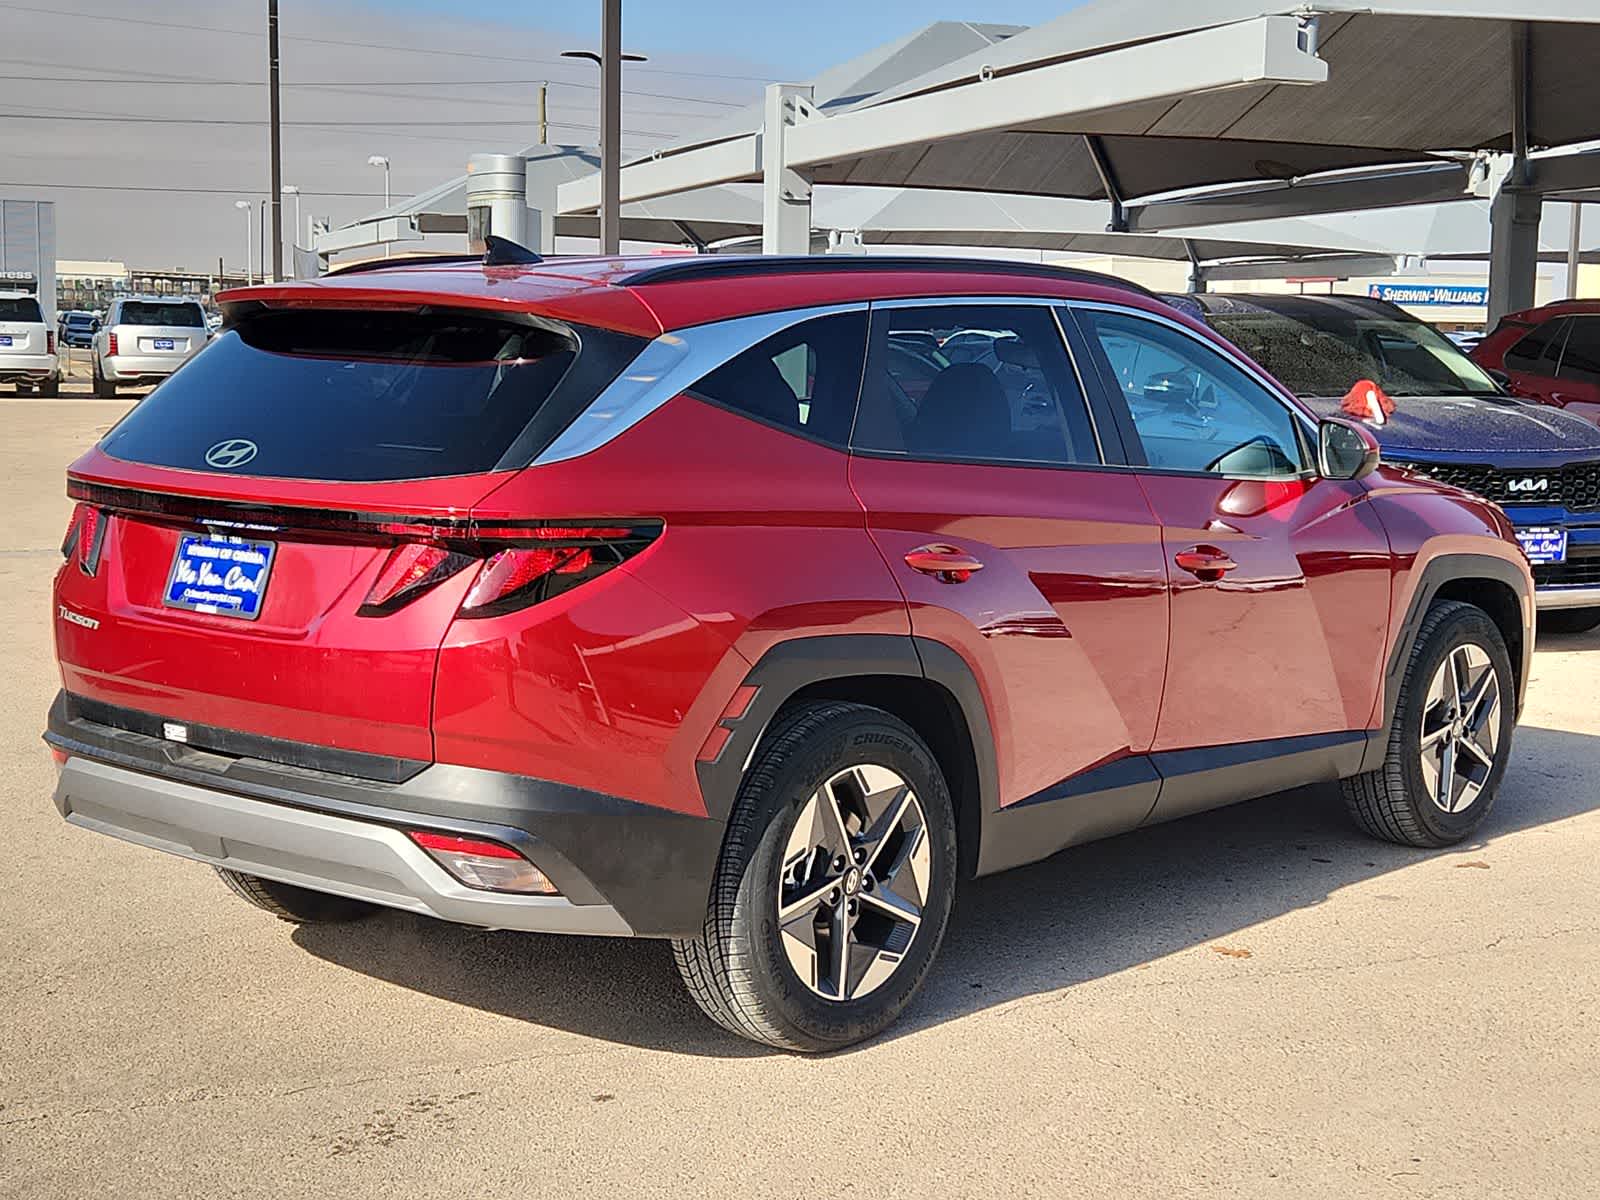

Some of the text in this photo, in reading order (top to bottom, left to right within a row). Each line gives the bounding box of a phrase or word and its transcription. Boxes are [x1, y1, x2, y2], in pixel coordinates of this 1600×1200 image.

[1382, 288, 1482, 303] SHERWIN-WILLIAMS
[1508, 479, 1548, 491] KIA
[197, 561, 224, 586] You
[224, 566, 265, 593] Can!
[58, 604, 100, 630] TUCSON
